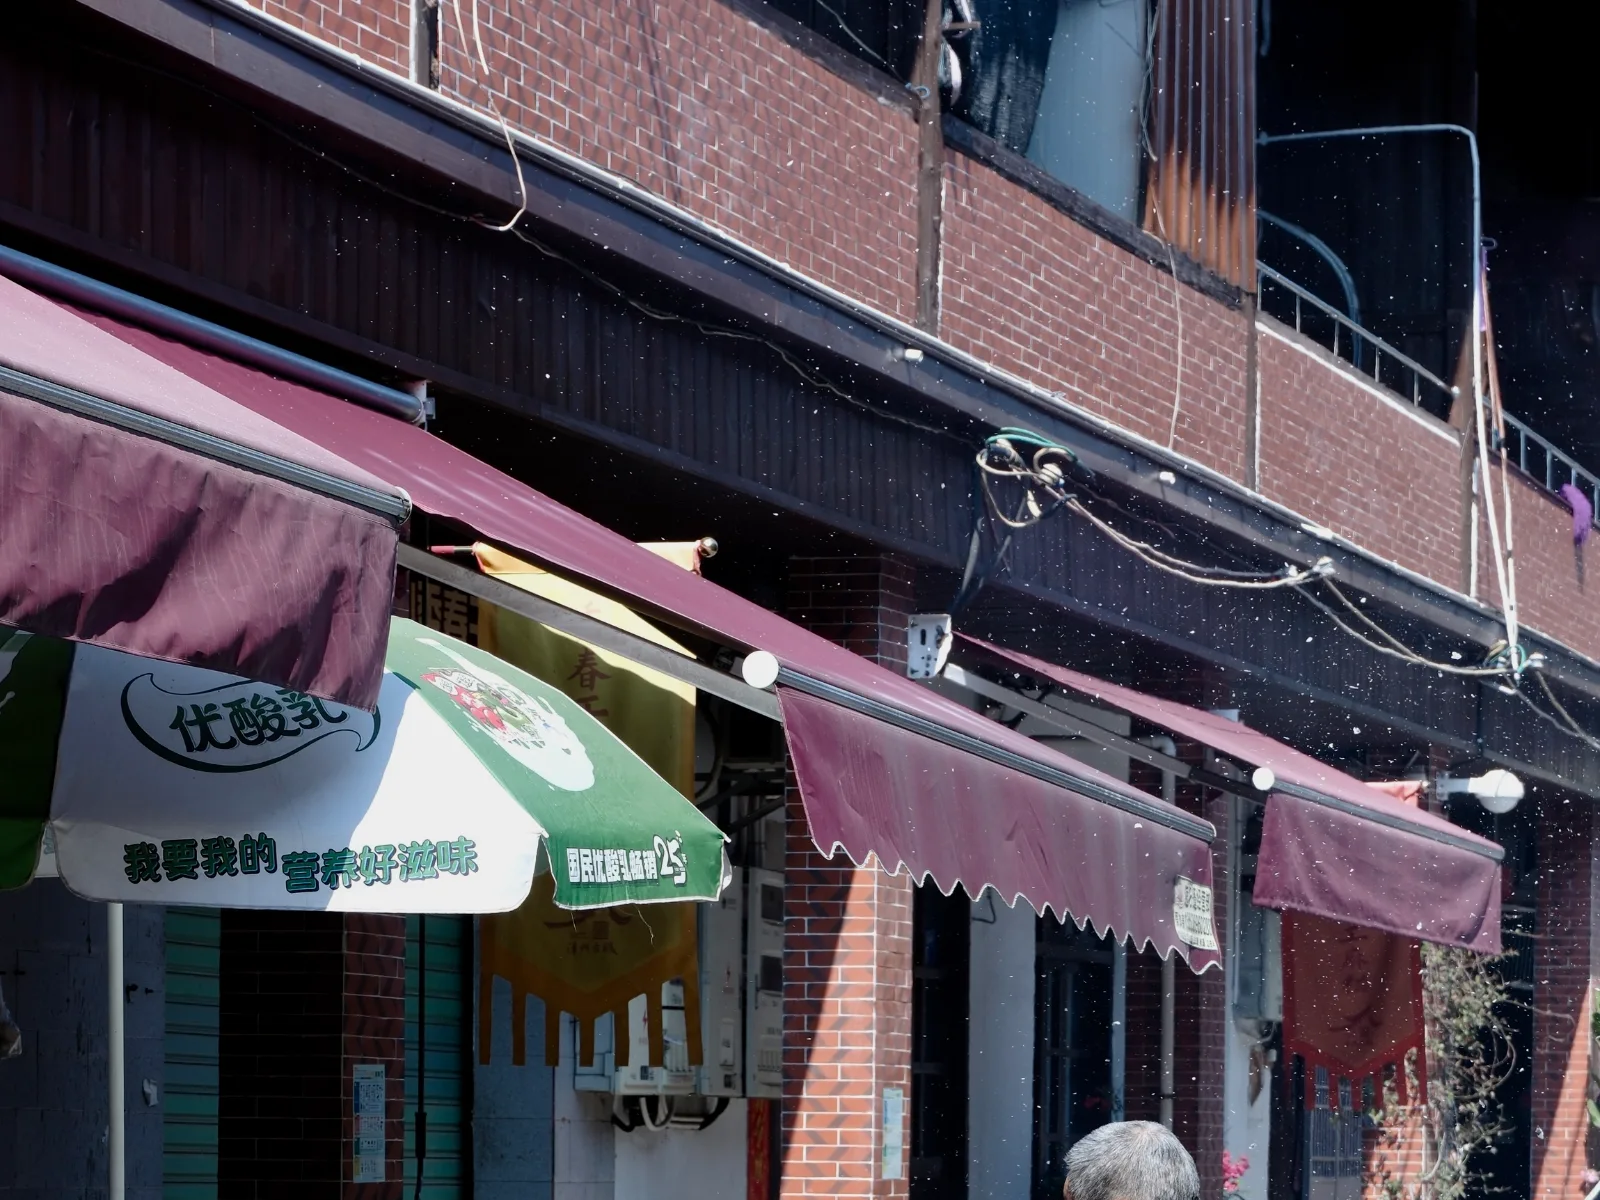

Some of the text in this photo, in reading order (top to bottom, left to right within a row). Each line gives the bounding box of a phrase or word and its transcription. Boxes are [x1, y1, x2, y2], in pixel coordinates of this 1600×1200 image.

[169, 687, 348, 752] 优酸乳
[123, 832, 479, 894] 我要我的 营养好滋味
